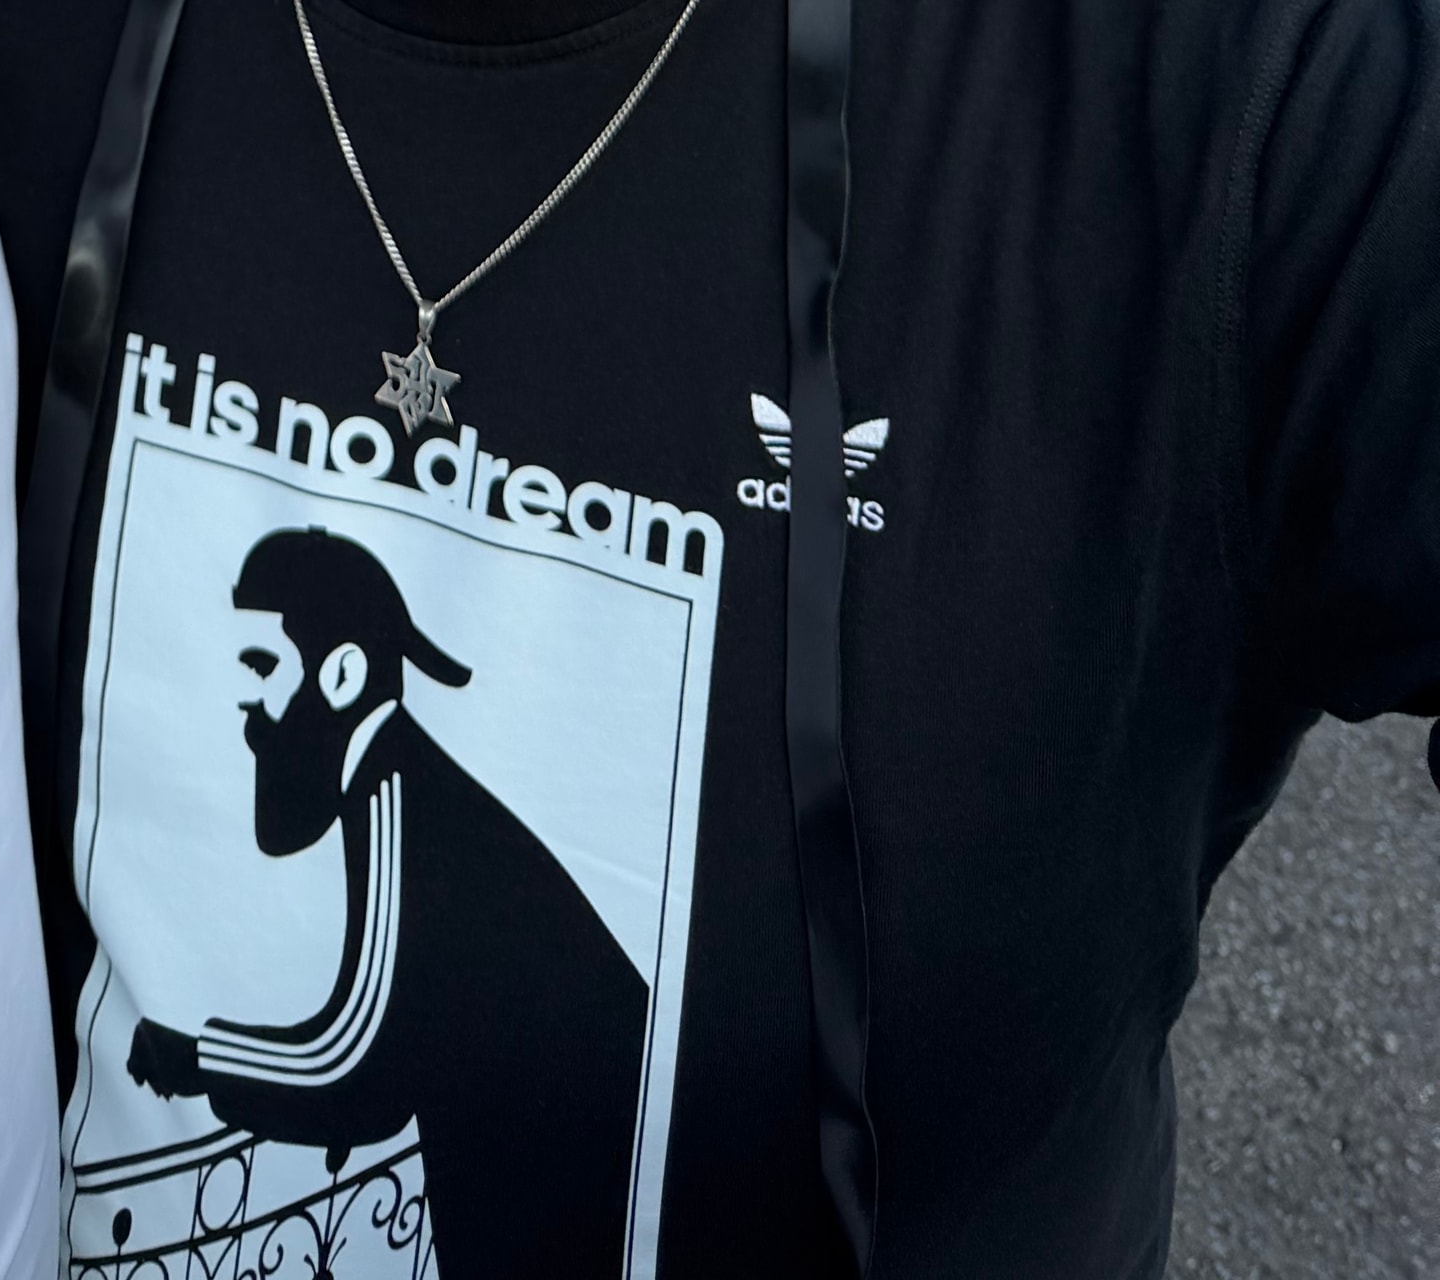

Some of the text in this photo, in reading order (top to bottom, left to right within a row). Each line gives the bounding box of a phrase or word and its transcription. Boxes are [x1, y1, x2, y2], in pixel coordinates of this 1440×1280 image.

[116, 332, 724, 577] it is no dream
